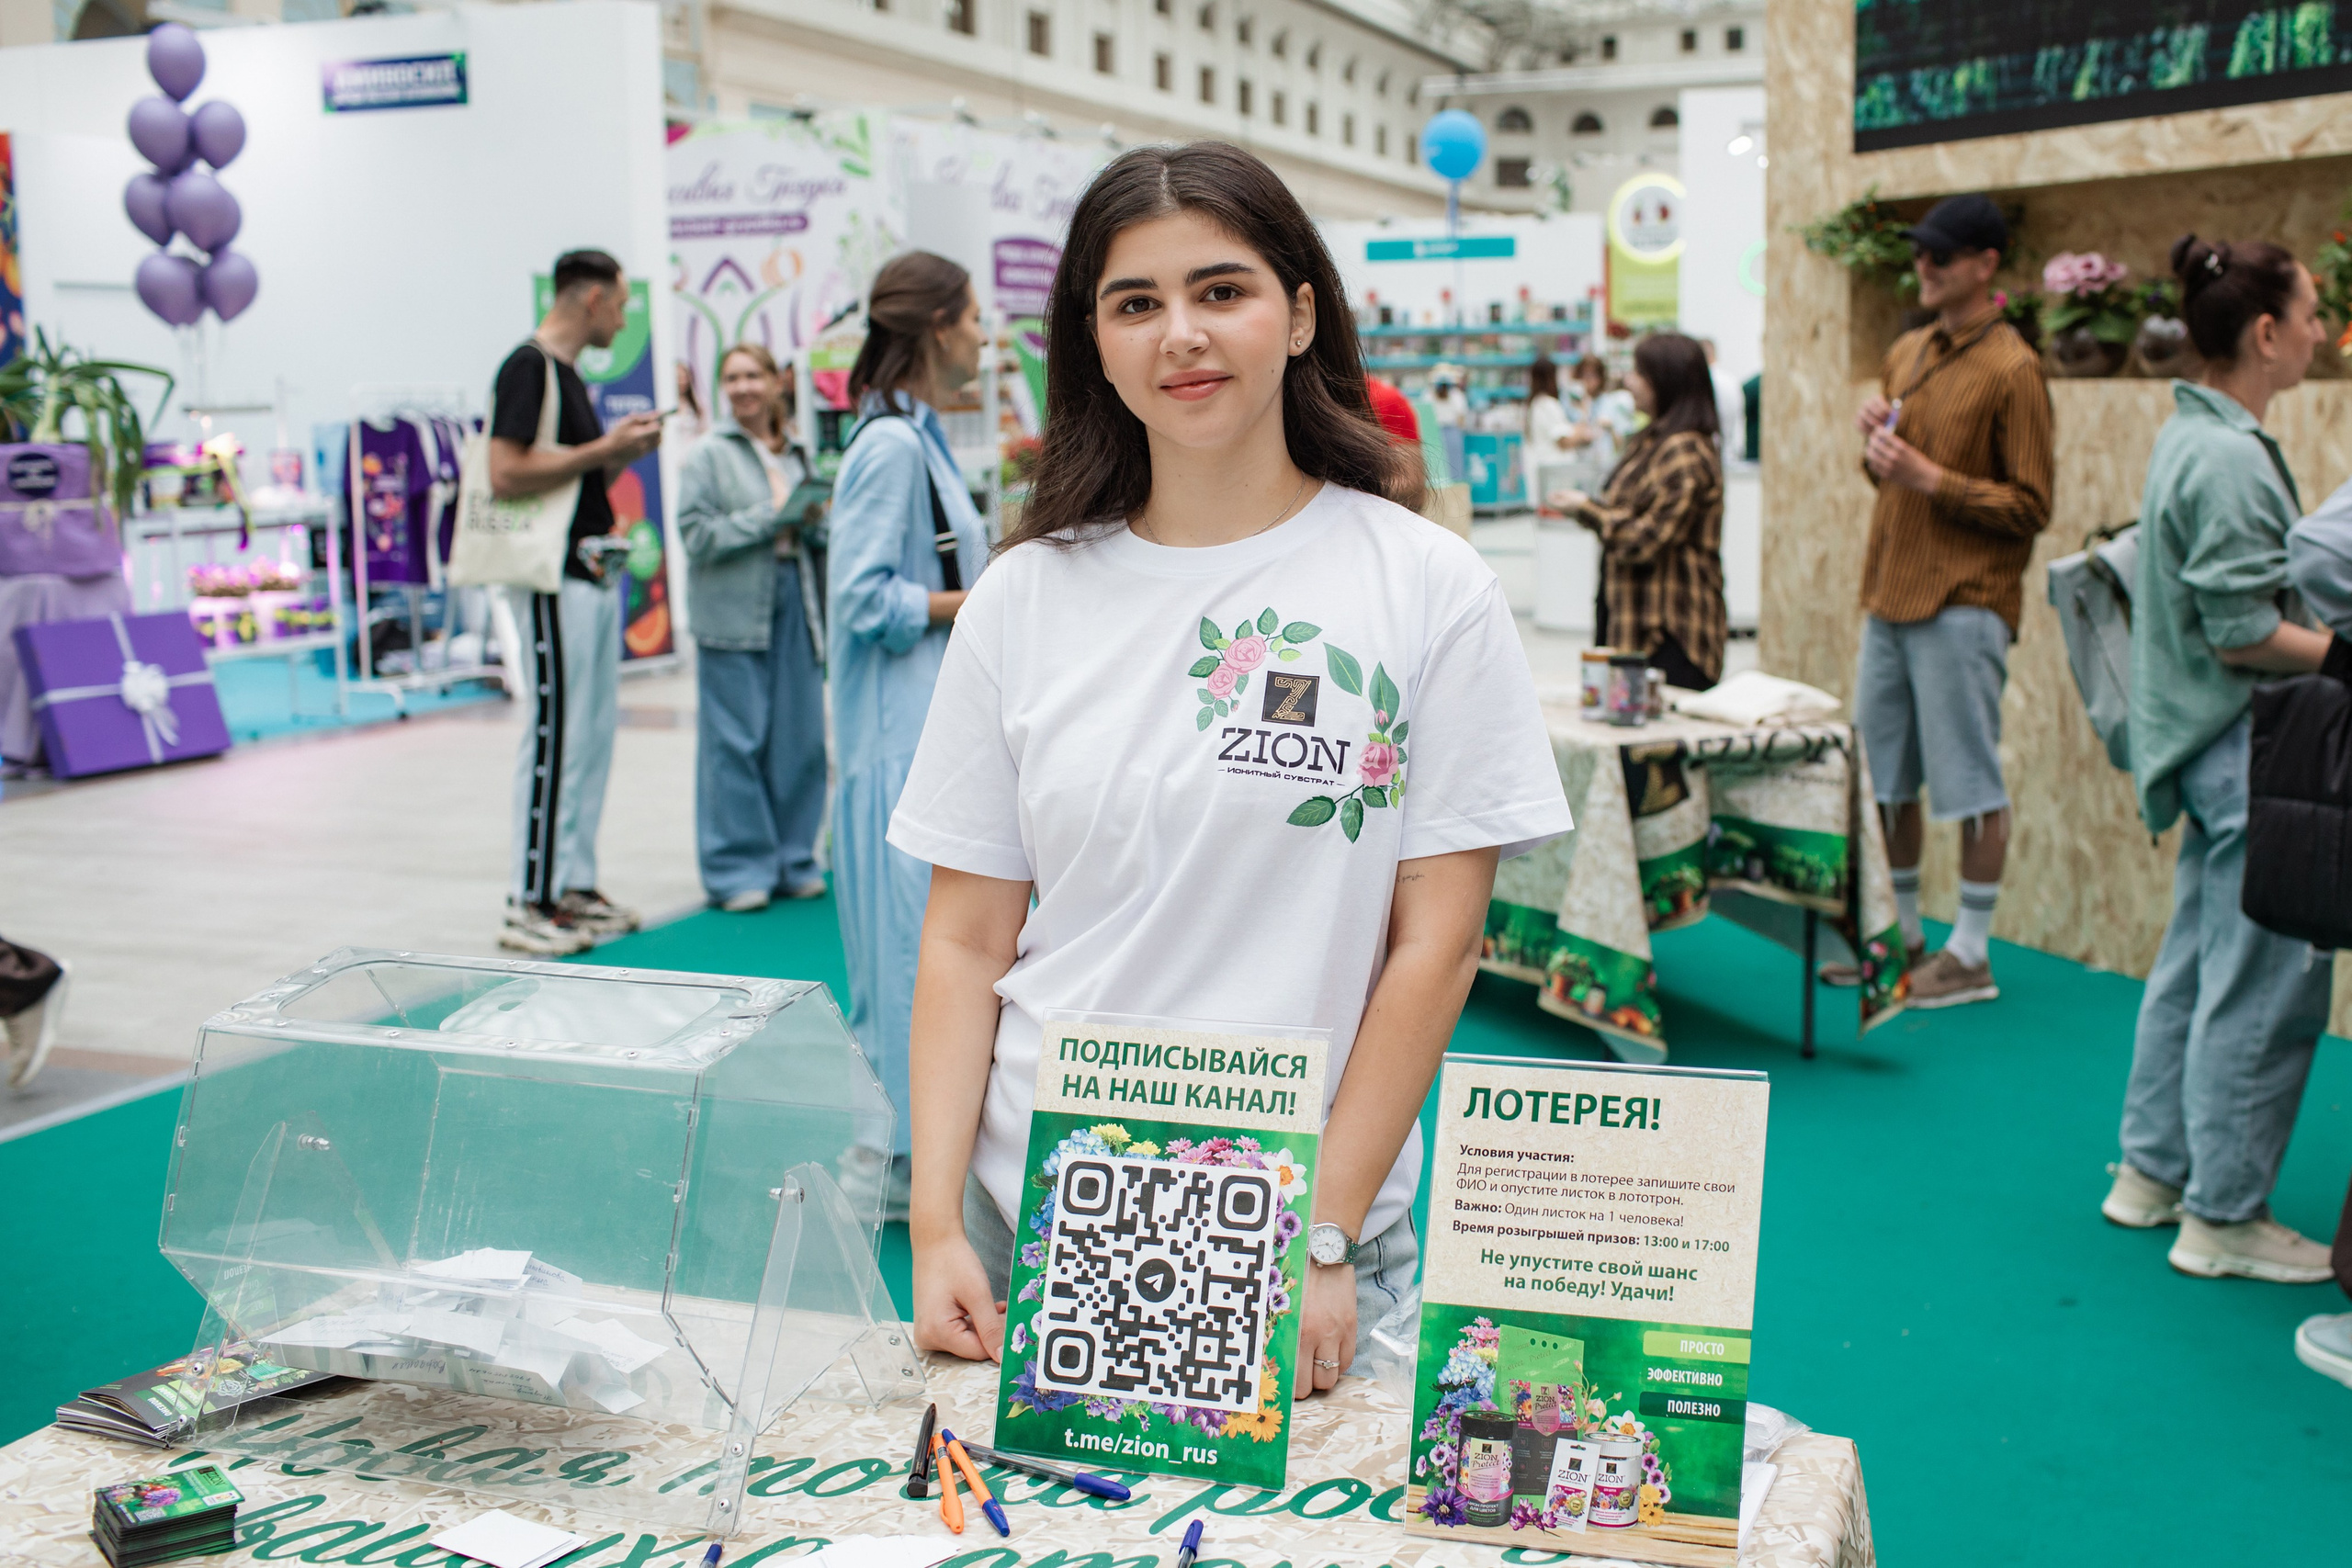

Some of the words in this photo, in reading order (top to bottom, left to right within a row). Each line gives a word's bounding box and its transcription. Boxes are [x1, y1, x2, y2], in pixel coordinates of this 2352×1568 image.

[1218, 728, 1351, 774] ZION
[1227, 767, 1282, 779] ИОНИТНЫЙ
[1283, 774, 1335, 787] СУБСТРАТ
[1058, 1037, 1308, 1079] ПОДПИСЫВАЙСЯ
[1061, 1073, 1101, 1100] НА
[1108, 1077, 1178, 1106] НАШ
[1185, 1083, 1297, 1116] КАНАЛ!
[1464, 1087, 1661, 1131] ЛОТЕРЕЯ!
[1459, 1145, 1514, 1161] Условия
[1517, 1149, 1575, 1164] участия:
[1456, 1163, 1482, 1178] Для
[1485, 1167, 1567, 1183] регистрации
[1570, 1172, 1578, 1181] в
[1580, 1172, 1634, 1189] лотерее
[1636, 1178, 1701, 1191] запишите
[1703, 1183, 1736, 1193] свои
[1456, 1178, 1487, 1192] ФИО
[1489, 1182, 1498, 1192] и
[1500, 1183, 1557, 1199] опустите
[1560, 1188, 1605, 1201] листок
[1608, 1191, 1616, 1201] в
[1618, 1191, 1684, 1208] лототрон.
[1454, 1200, 1502, 1214] Важно:
[1504, 1203, 1539, 1219] Один
[1542, 1207, 1587, 1221] листок
[1589, 1212, 1605, 1222] на
[1608, 1210, 1615, 1223] 1
[1619, 1213, 1684, 1227] человека!
[1453, 1220, 1494, 1238] Время
[1496, 1225, 1585, 1244] розыгрышей
[1588, 1233, 1640, 1249] призов:
[1643, 1235, 1679, 1249] 13:00
[1681, 1240, 1690, 1249] и
[1694, 1239, 1730, 1252] 17:00
[1480, 1249, 1505, 1266] Не
[1509, 1254, 1593, 1275] упустите
[1598, 1258, 1644, 1278] свой
[1647, 1266, 1698, 1281] шанс
[1504, 1277, 1526, 1290] на
[1531, 1276, 1606, 1299] победу!
[1611, 1280, 1675, 1303] Удачи!
[1679, 1339, 1725, 1356] ПРОСТО
[1646, 1367, 1724, 1387] ЭФФЕКТИВНО
[1535, 1394, 1555, 1403] ZION
[1667, 1399, 1722, 1417] ПОЛЕЗНО
[1064, 1428, 1218, 1465] t.me/zion_rus
[1474, 1452, 1498, 1461] ZION
[1471, 1459, 1500, 1470] Protect
[1557, 1469, 1589, 1483] ZION
[1598, 1472, 1623, 1483] ZION
